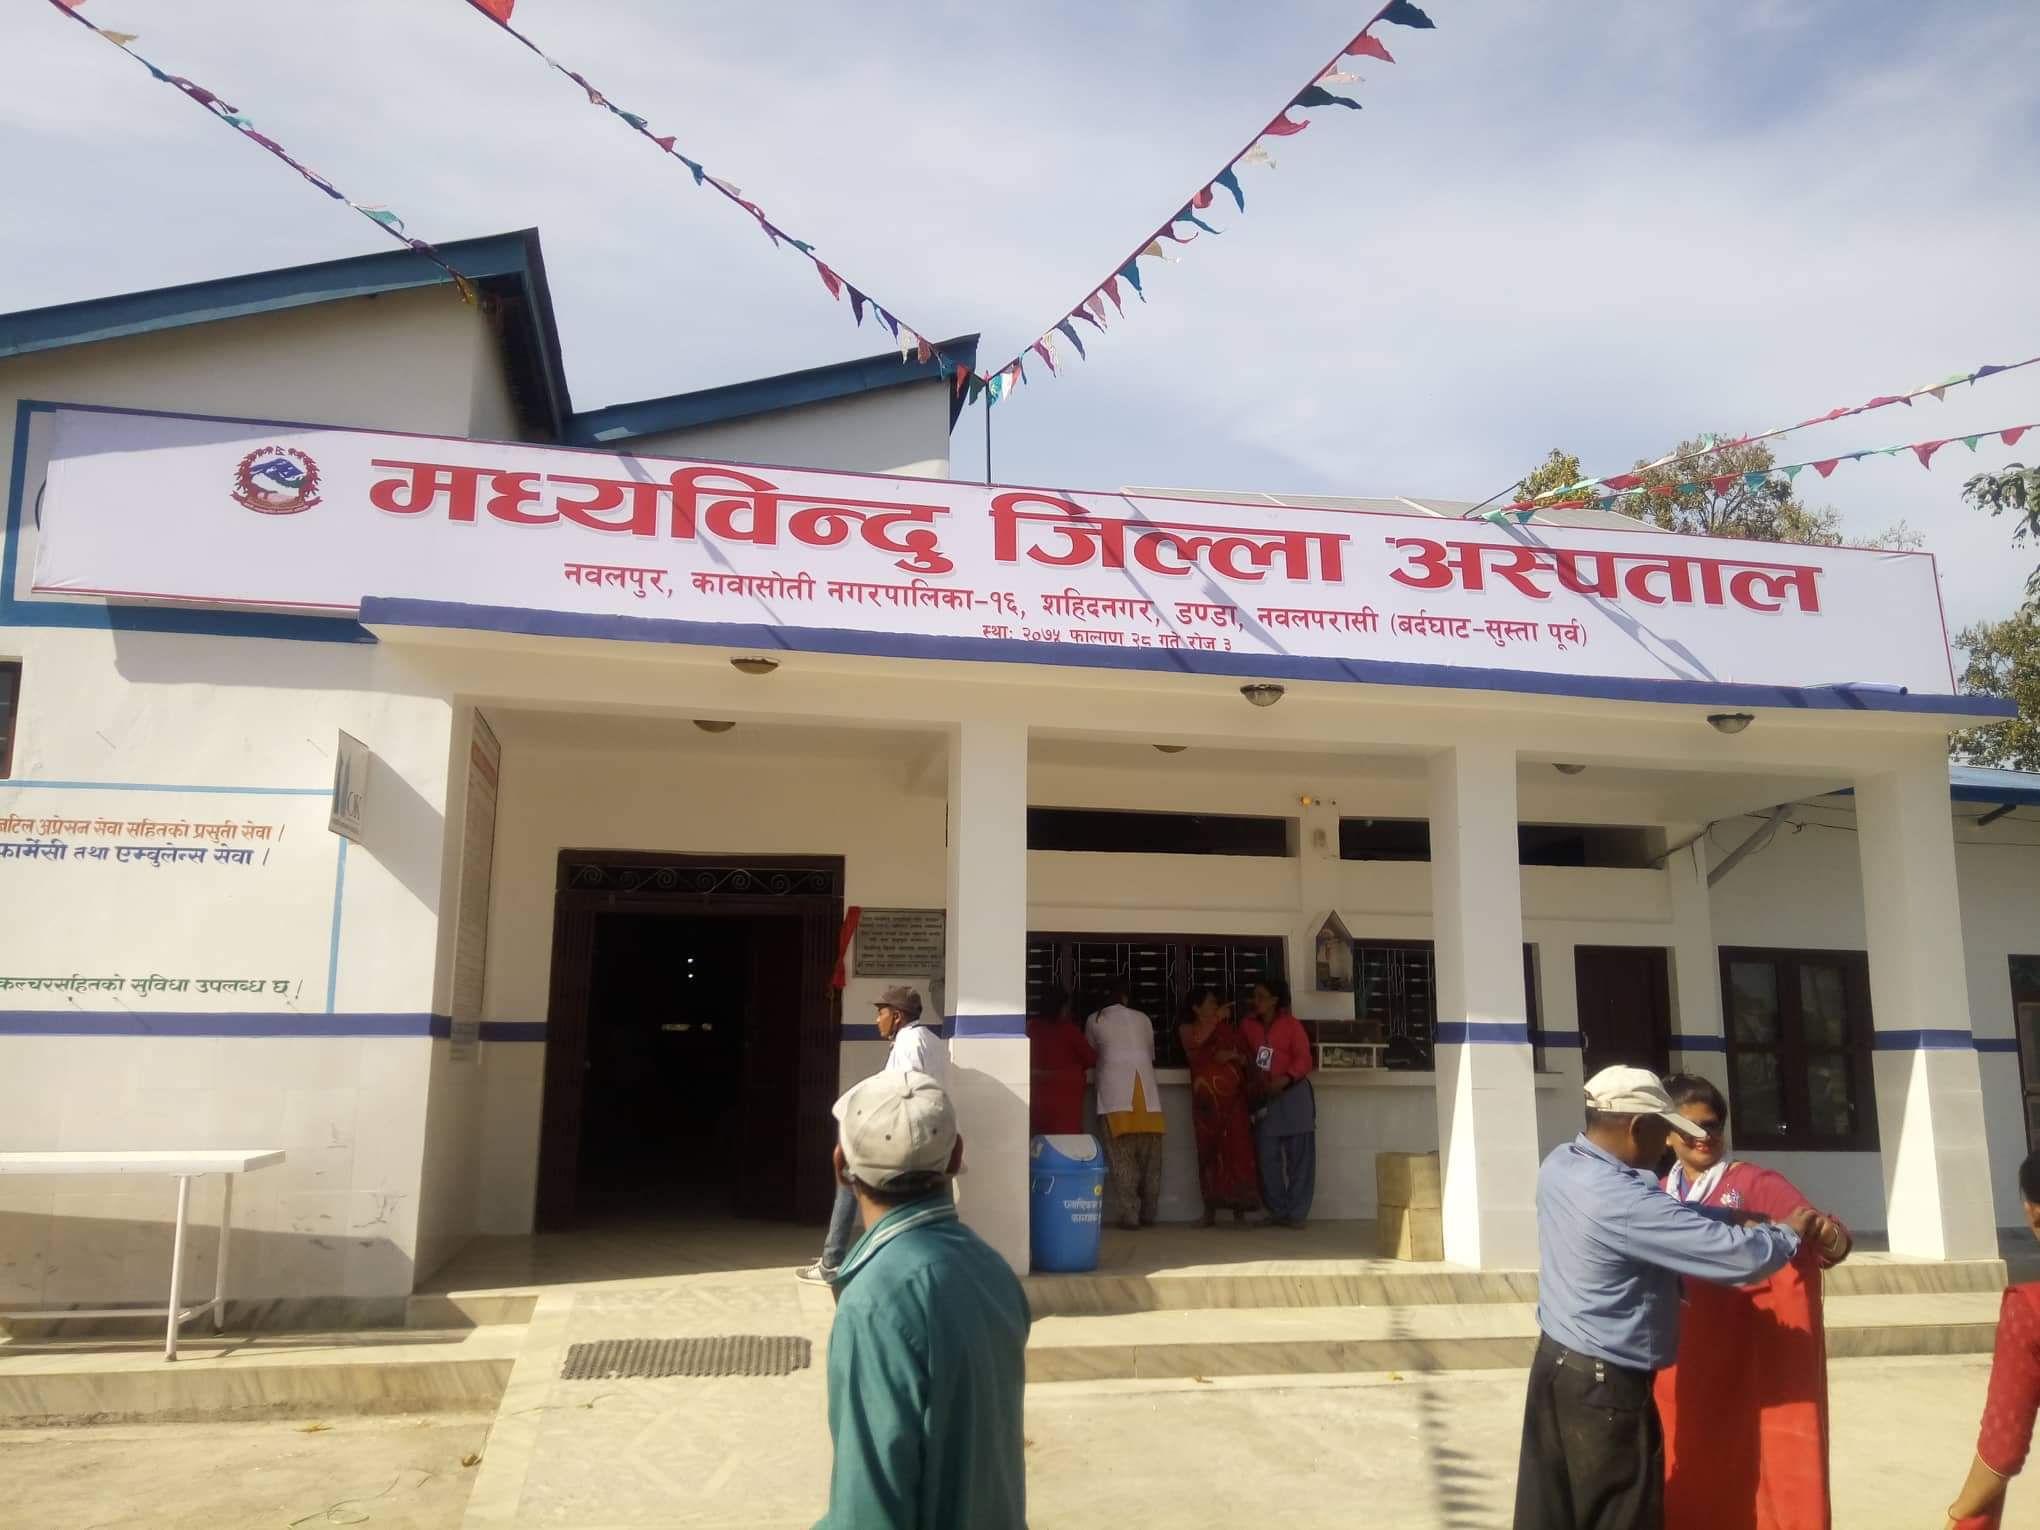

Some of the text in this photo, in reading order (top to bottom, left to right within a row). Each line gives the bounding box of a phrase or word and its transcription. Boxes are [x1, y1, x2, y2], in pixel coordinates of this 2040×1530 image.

[369, 459, 1822, 613] मध्यविन्दु जिल्ला अस्पताल
[563, 562, 673, 598] नवलपुर,
[689, 570, 817, 601] कावासोती
[826, 577, 1027, 620] नगरपालिका-१६,
[1040, 586, 1161, 627] शहिदनगर,
[1174, 601, 1244, 632] डण्डा,
[1256, 605, 1380, 633] नवलपरासी
[1547, 618, 1588, 651] पूर्व)
[127, 818, 190, 838] सहितको
[241, 821, 273, 840] सेवा
[73, 845, 111, 861] तथा
[213, 842, 255, 865] सेवा
[130, 973, 190, 998] सुविधा
